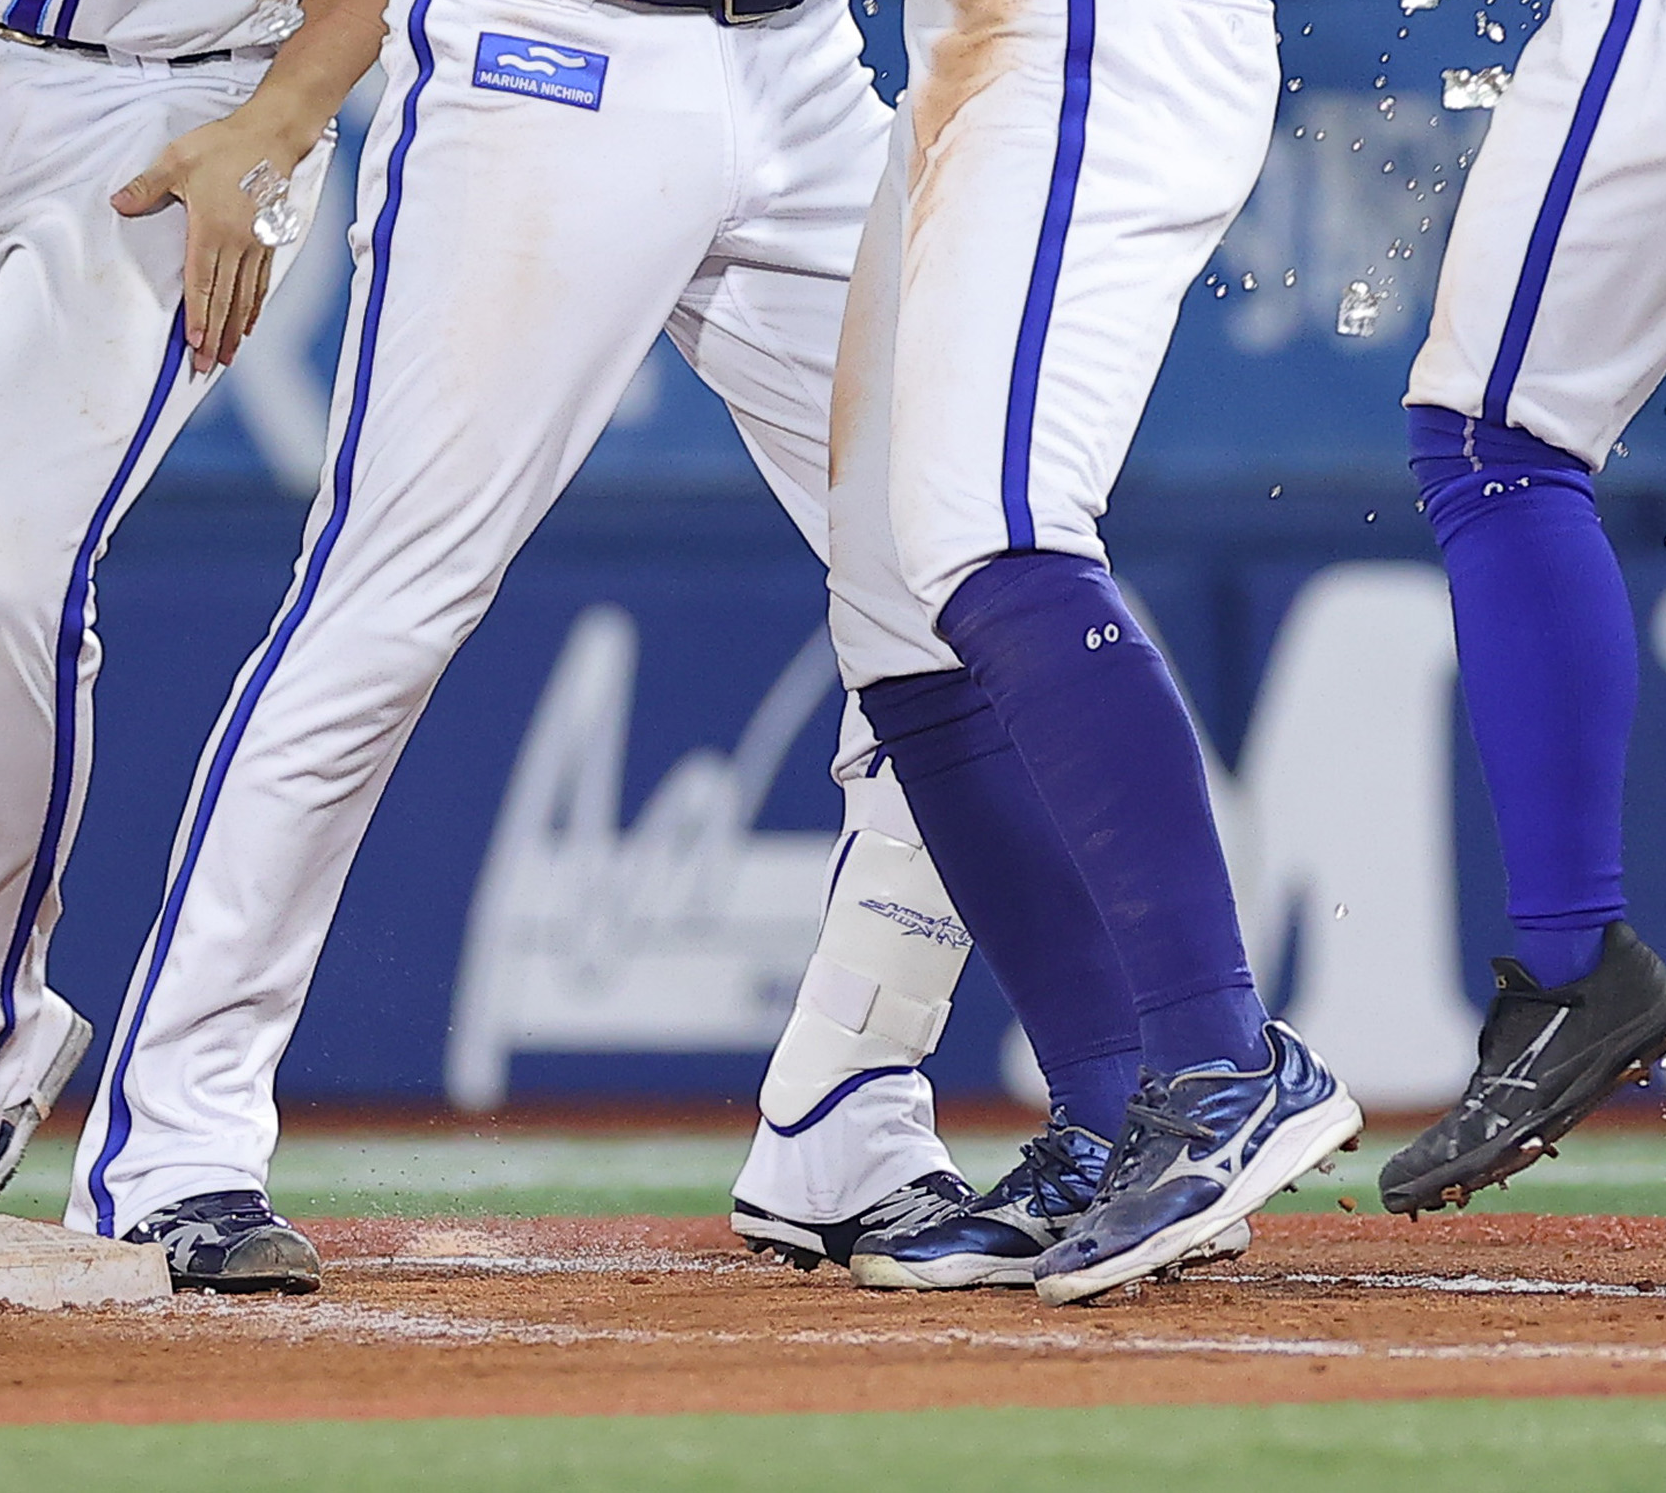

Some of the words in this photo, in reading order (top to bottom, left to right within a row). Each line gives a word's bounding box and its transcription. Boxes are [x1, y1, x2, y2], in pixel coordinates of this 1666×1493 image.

[479, 71, 538, 93] MARUHA
[540, 81, 595, 105] NICHIRO
[1086, 622, 1120, 650] 60
